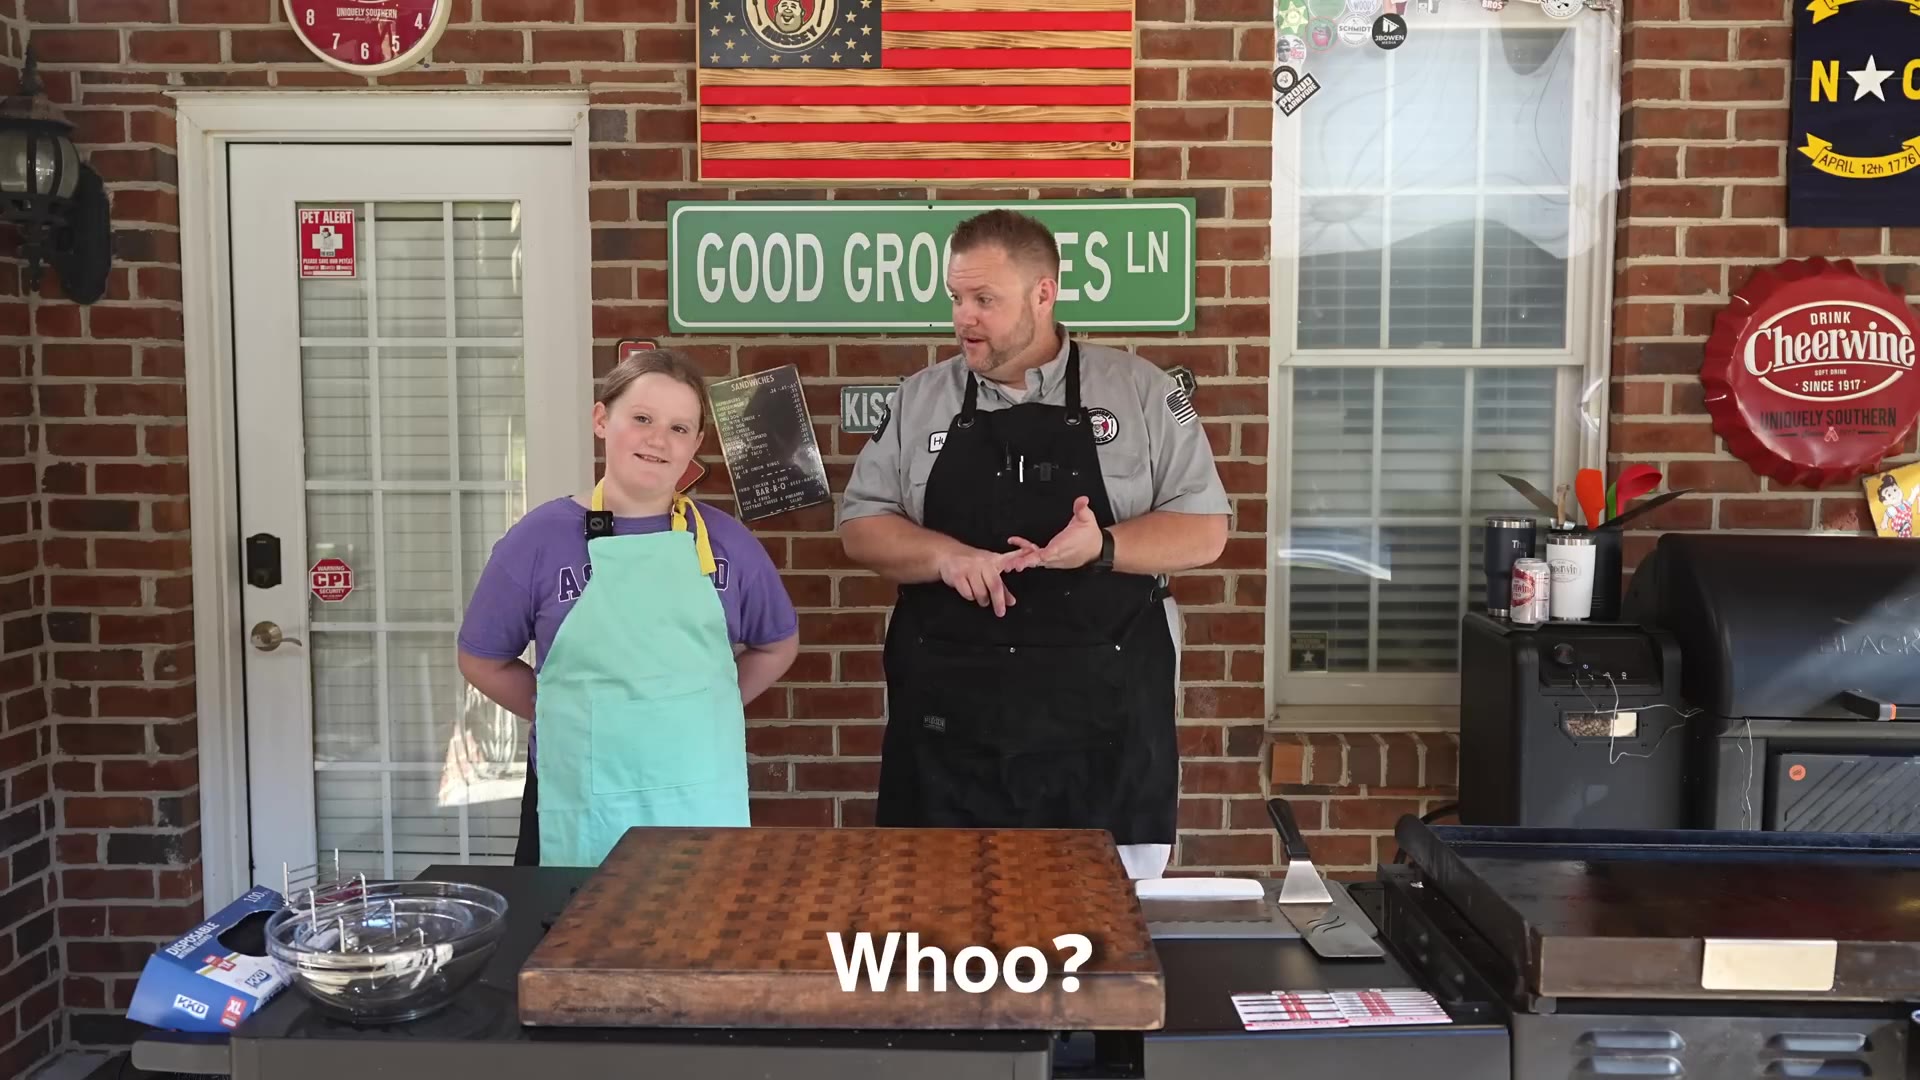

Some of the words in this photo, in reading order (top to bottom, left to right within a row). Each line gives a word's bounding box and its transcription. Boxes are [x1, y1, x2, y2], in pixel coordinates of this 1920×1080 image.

[306, 9, 314, 26] 8
[336, 8, 364, 16] UNIQUELY
[366, 8, 398, 19] SOUTHERN
[414, 13, 422, 29] 4
[332, 33, 340, 49] 7
[392, 36, 400, 52] 5
[360, 42, 369, 60] 6
[1810, 60, 1840, 102] N
[1902, 58, 1920, 100] C
[1278, 76, 1313, 108] PROUD
[1283, 82, 1318, 113] CARNIVORE
[1819, 154, 1854, 174] APRIL
[1862, 164, 1884, 174] 12th
[1888, 153, 1916, 172] 1776
[302, 212, 320, 224] PET
[323, 212, 352, 224] ALERT
[696, 232, 824, 303] GOOD
[843, 231, 1112, 303] GROES
[1128, 232, 1168, 273] LN
[1810, 312, 1851, 325] DRINK
[1744, 322, 1915, 376] Cheerwine
[731, 374, 775, 392] SANDWICHES
[1802, 380, 1834, 392] SINCE
[1838, 379, 1860, 391] 1917
[1760, 411, 1822, 430] UNIQUELY
[1826, 408, 1896, 426] SOUTHERN
[313, 574, 350, 586] CPI
[244, 892, 264, 902] 100
[165, 922, 220, 956] DISPOSABLE
[194, 934, 212, 947] GLOVES
[246, 970, 267, 986] KKD
[178, 997, 206, 1015] KKD
[227, 1000, 241, 1014] XL
